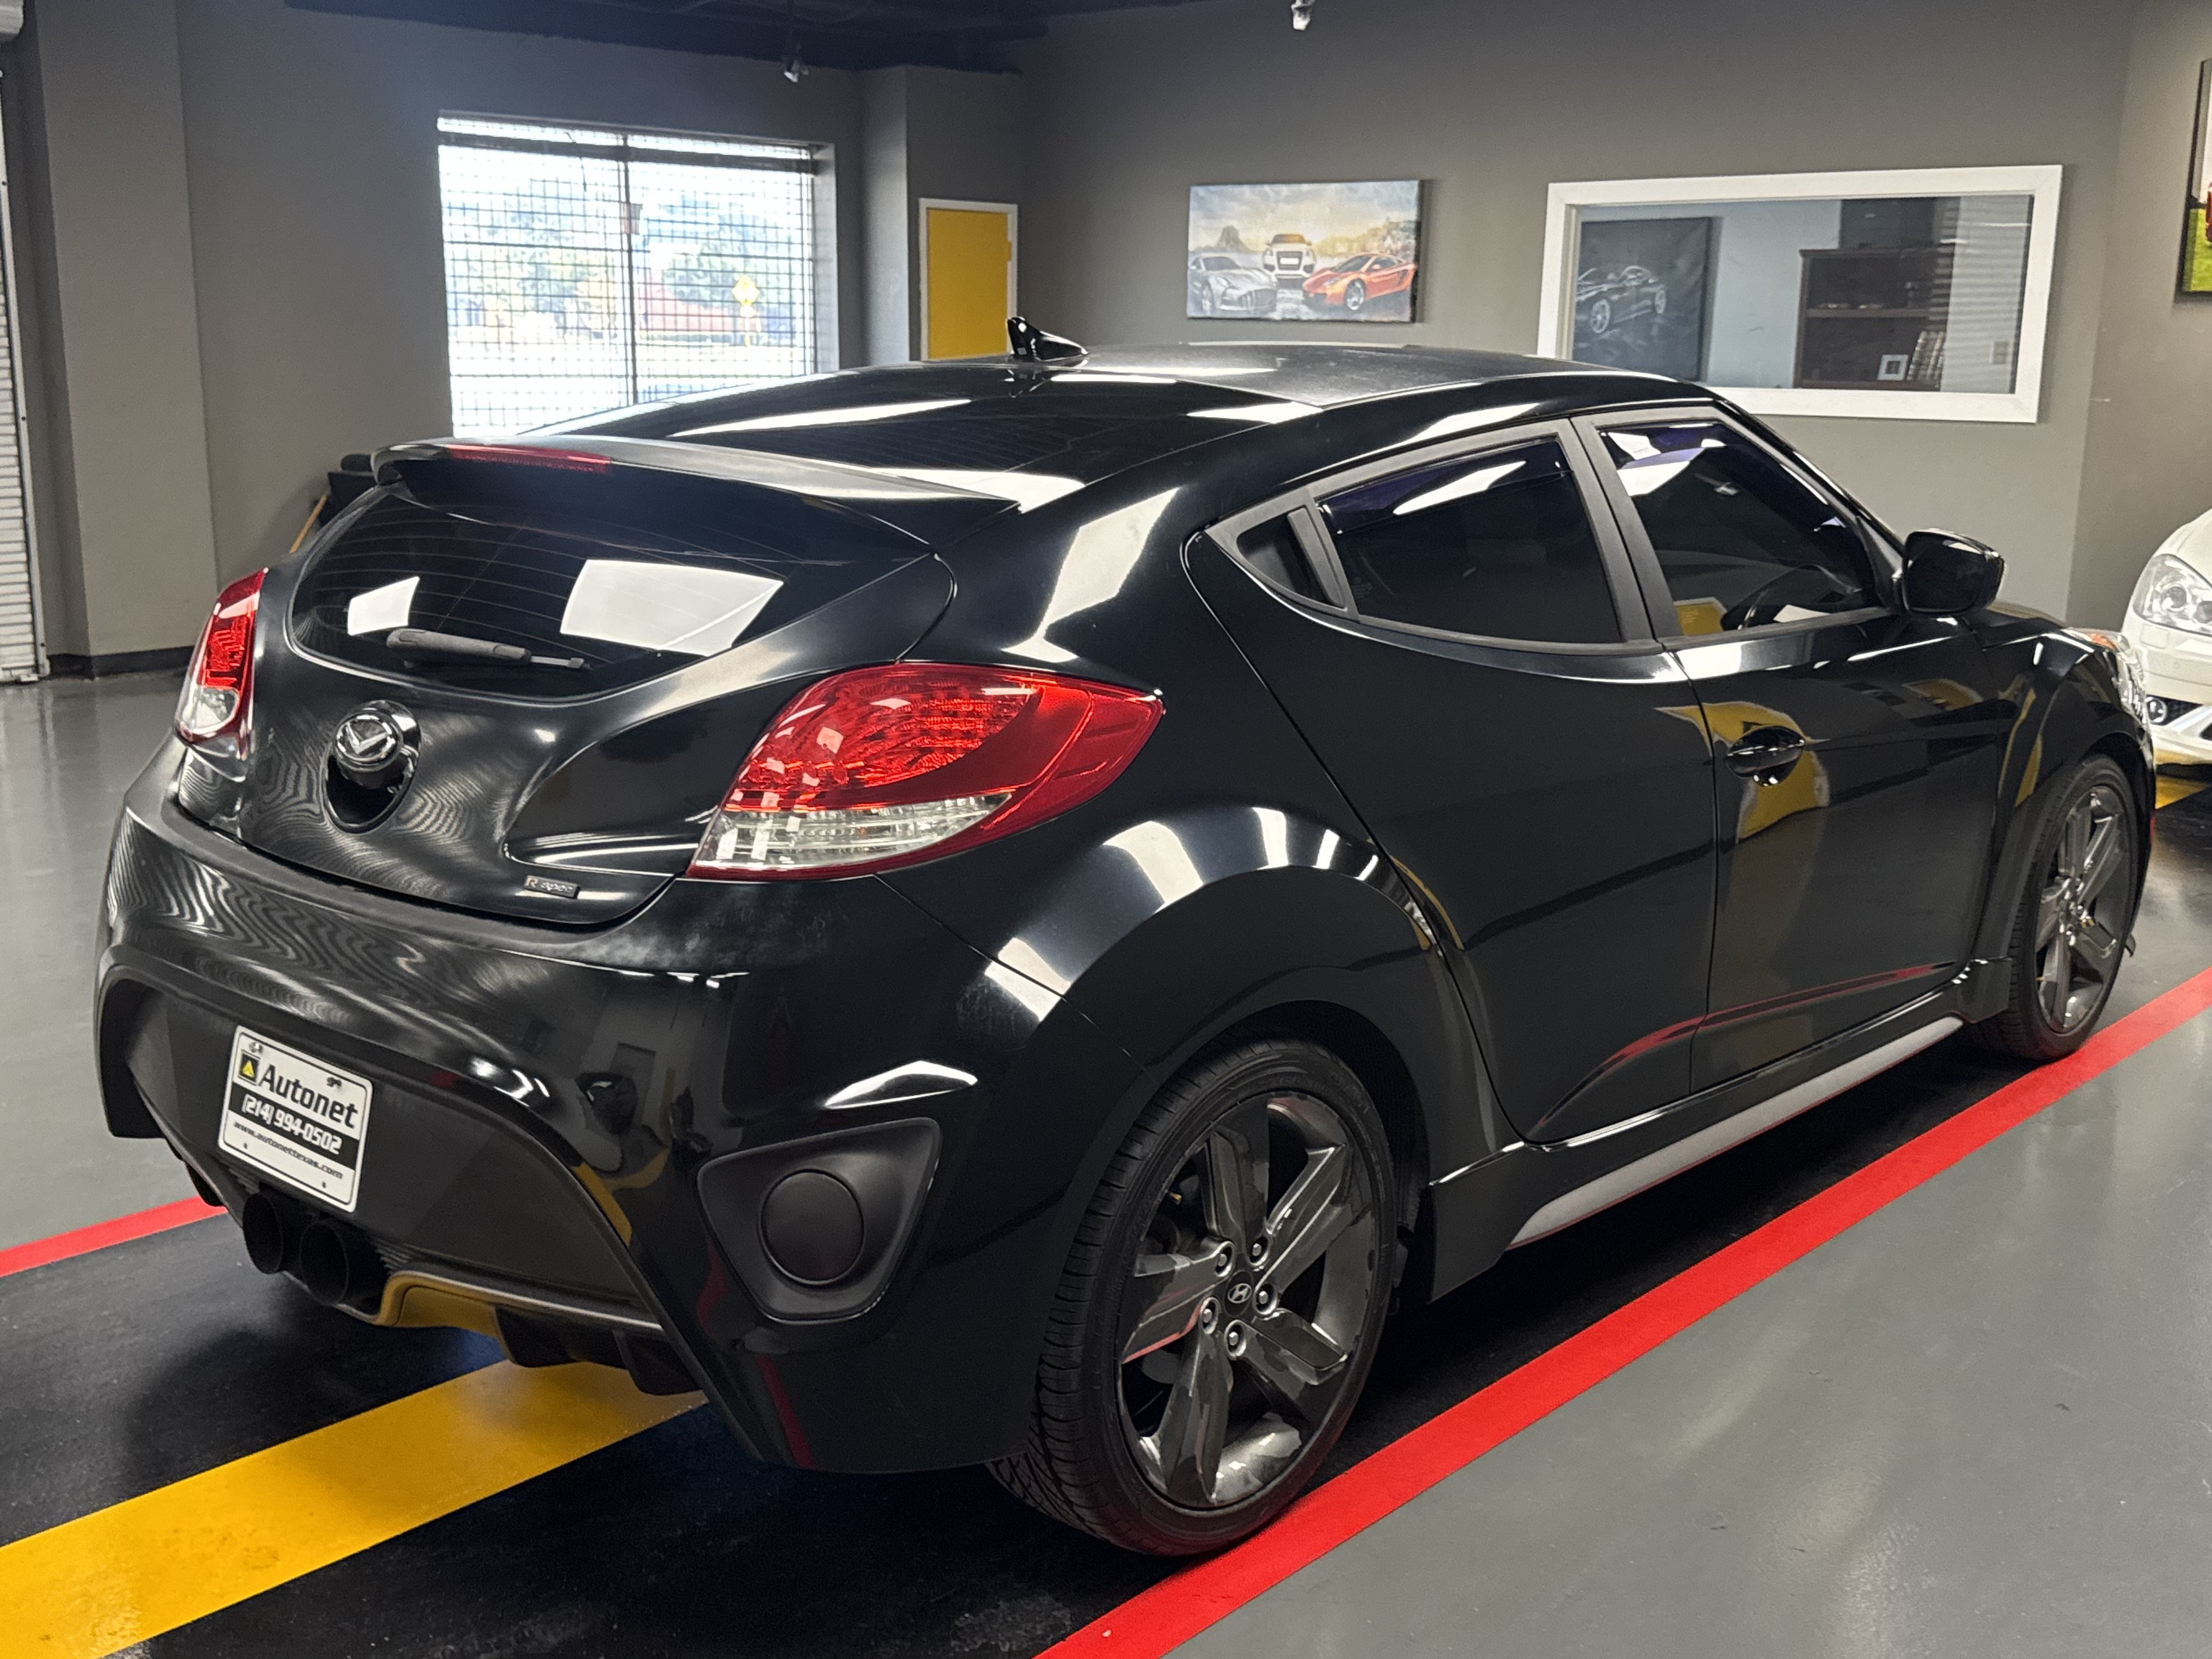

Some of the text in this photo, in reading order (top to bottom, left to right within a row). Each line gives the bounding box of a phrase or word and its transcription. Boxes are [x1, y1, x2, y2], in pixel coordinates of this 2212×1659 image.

[241, 1093, 342, 1155] (214) 994-0502
[259, 1064, 358, 1129] Autonet
